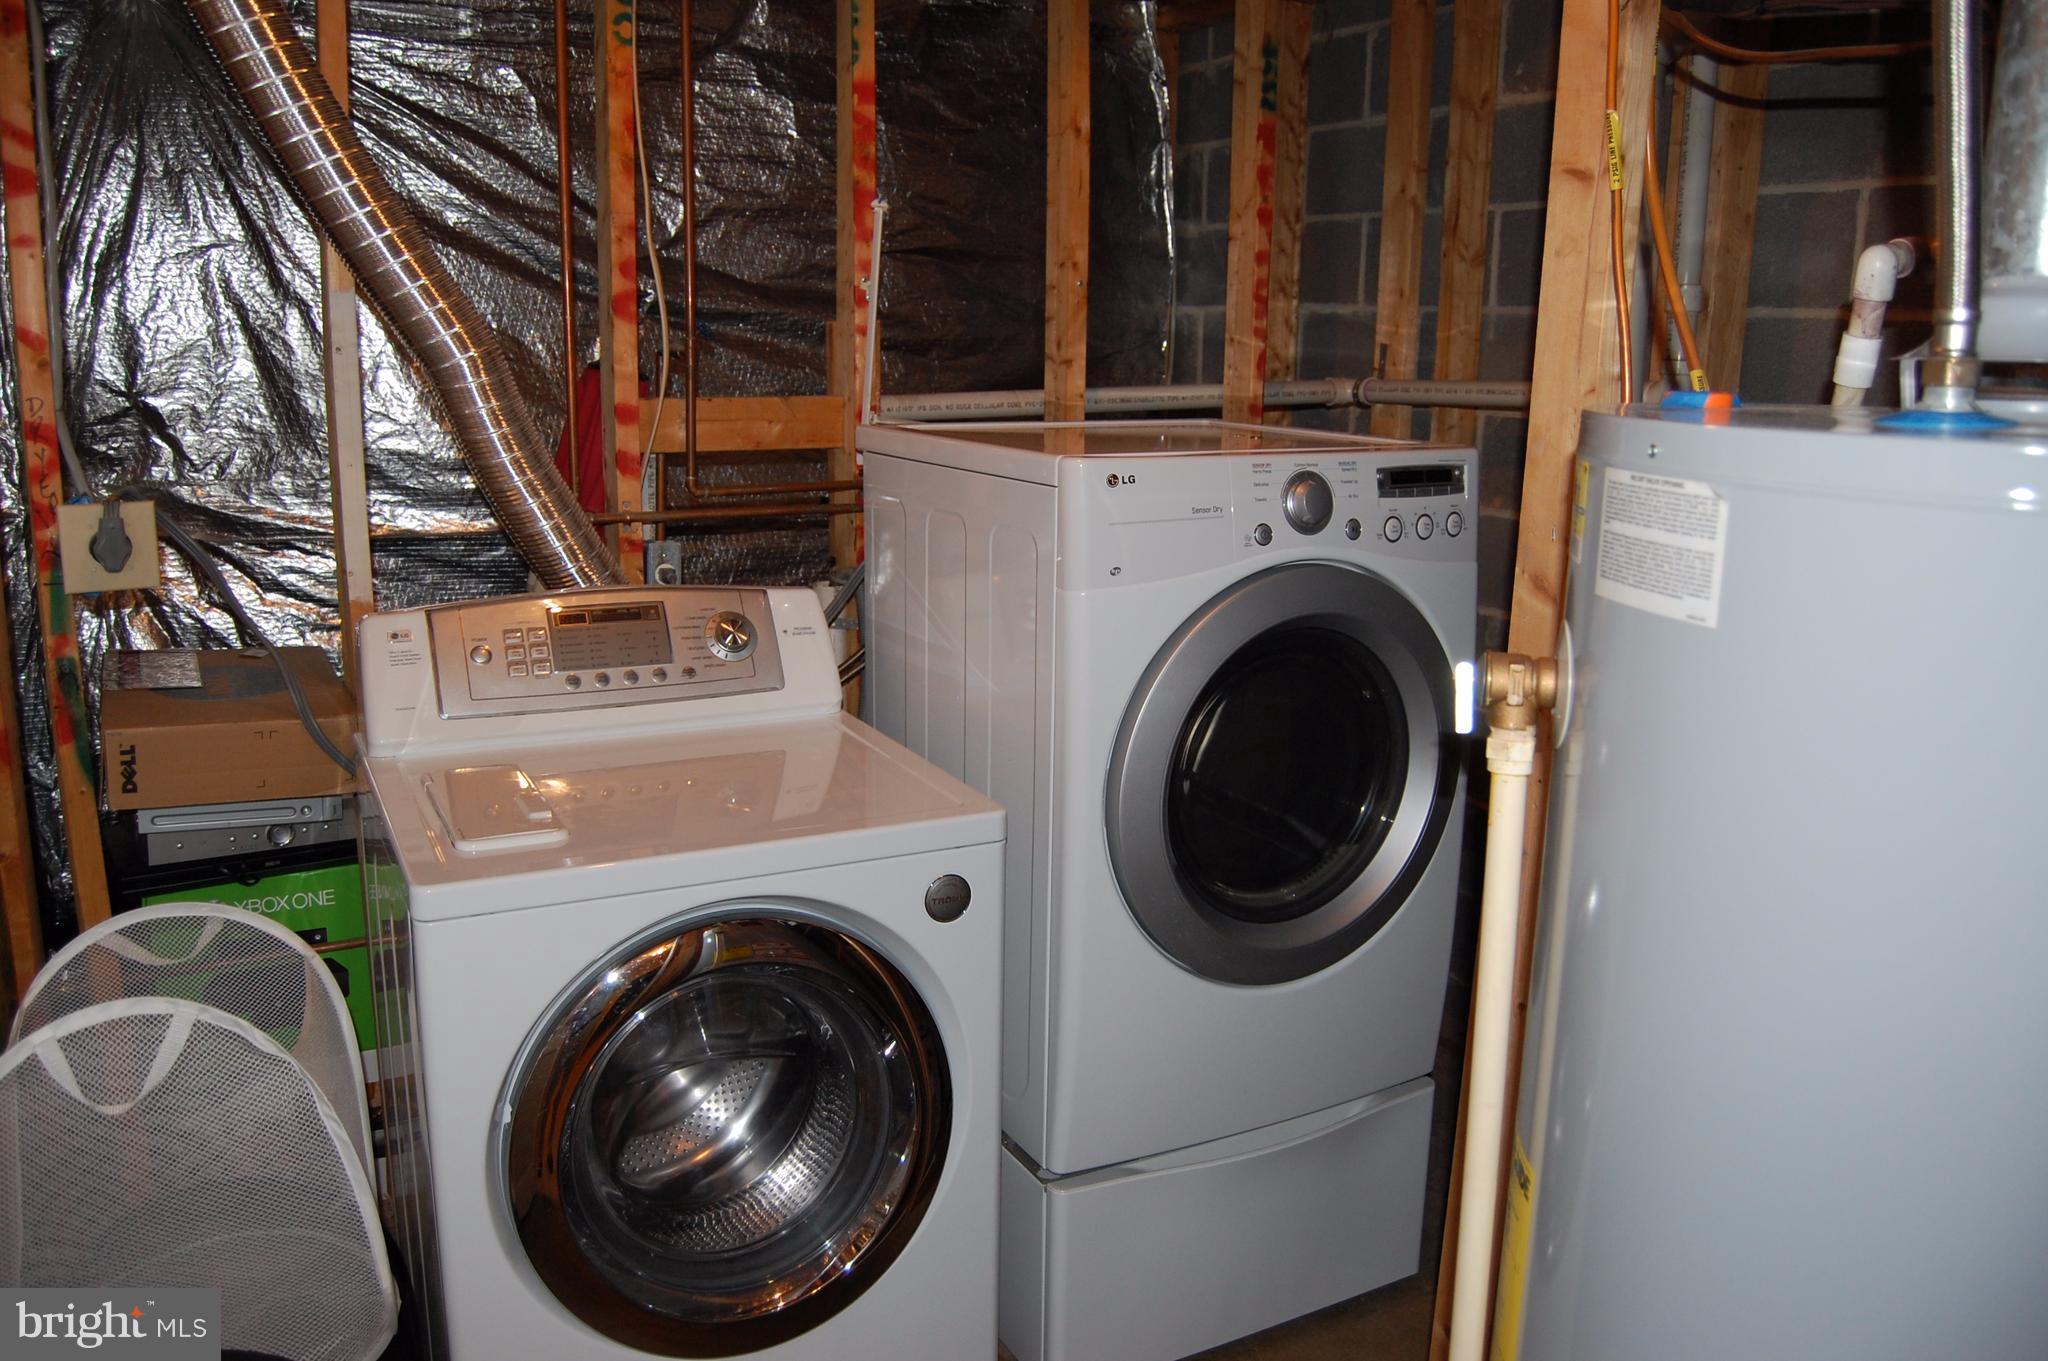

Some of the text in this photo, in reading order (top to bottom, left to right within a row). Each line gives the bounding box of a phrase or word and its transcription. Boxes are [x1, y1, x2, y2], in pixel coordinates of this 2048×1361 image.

[1608, 146, 1617, 160] LINE
[1121, 474, 1136, 485] LG
[1191, 504, 1224, 515] Sensor Dry
[119, 744, 138, 794] DELL
[234, 888, 336, 914] XBOX ONE
